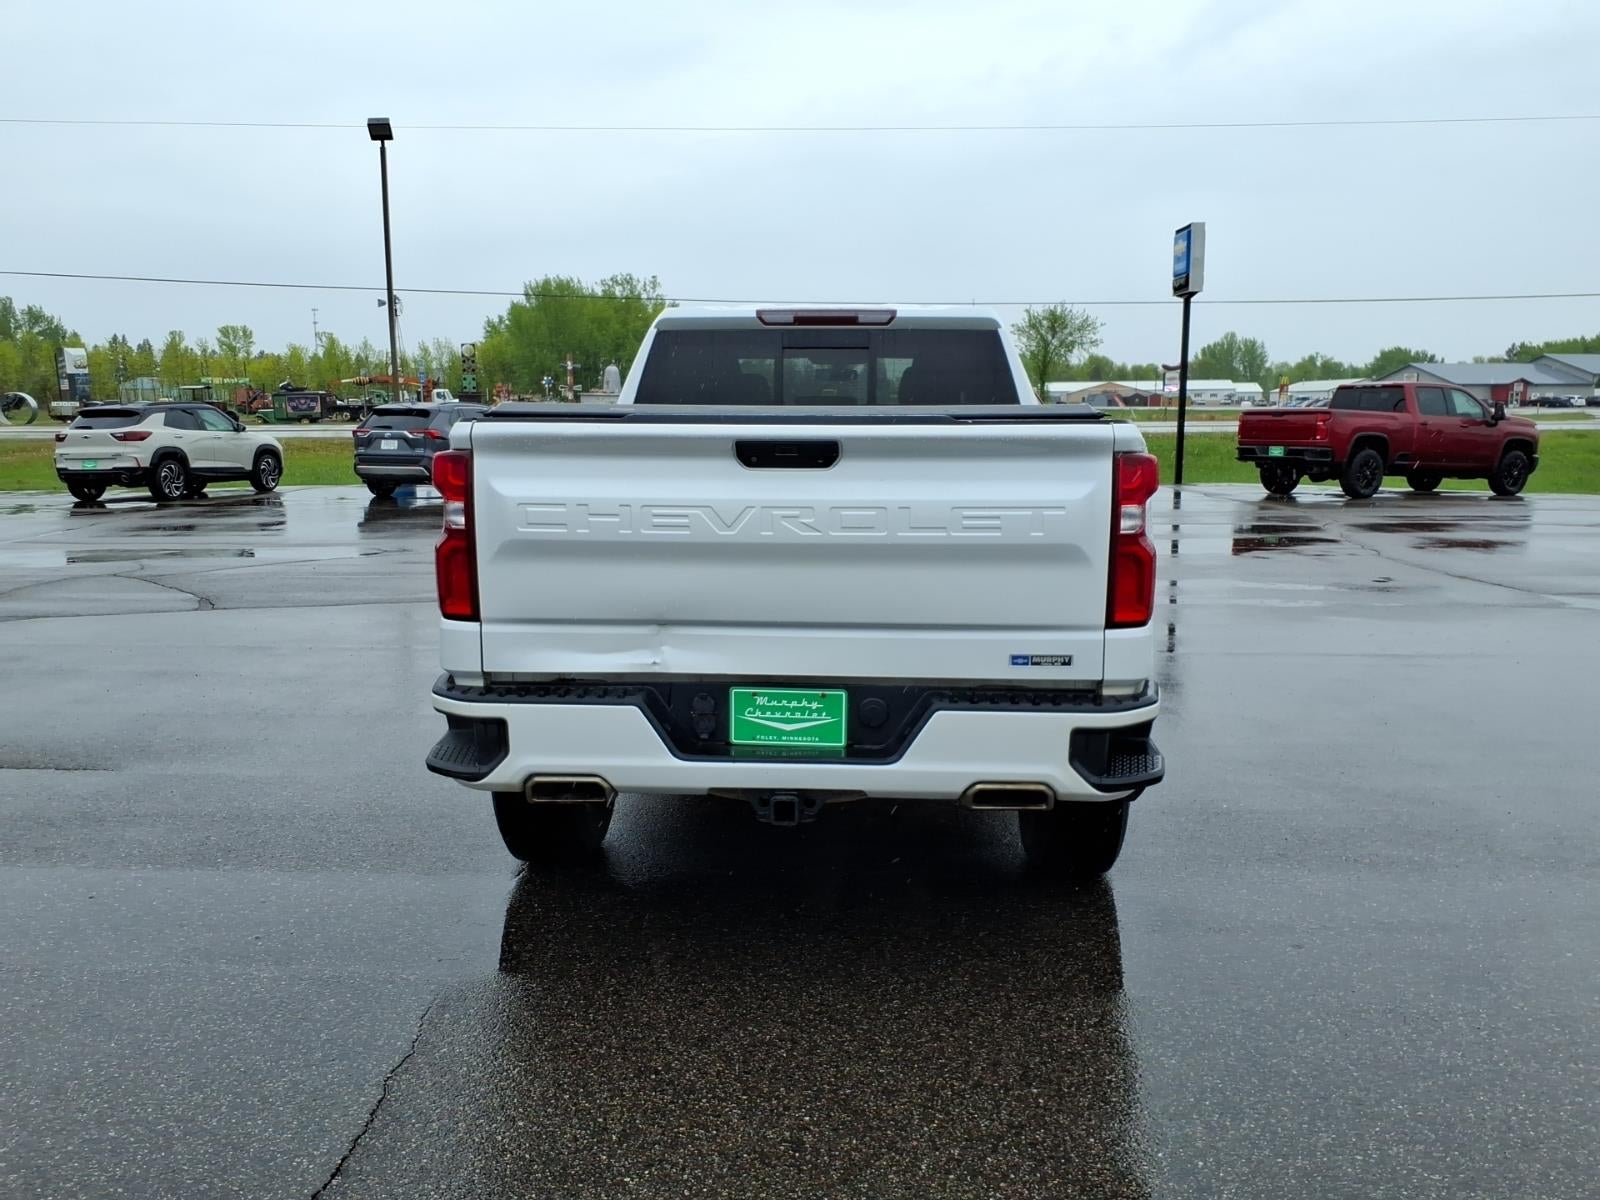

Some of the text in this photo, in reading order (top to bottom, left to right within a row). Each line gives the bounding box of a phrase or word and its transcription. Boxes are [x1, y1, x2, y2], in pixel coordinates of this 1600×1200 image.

[516, 502, 1067, 536] CHEVROLET
[753, 696, 824, 709] Murphy
[744, 707, 832, 720] Chevrolet
